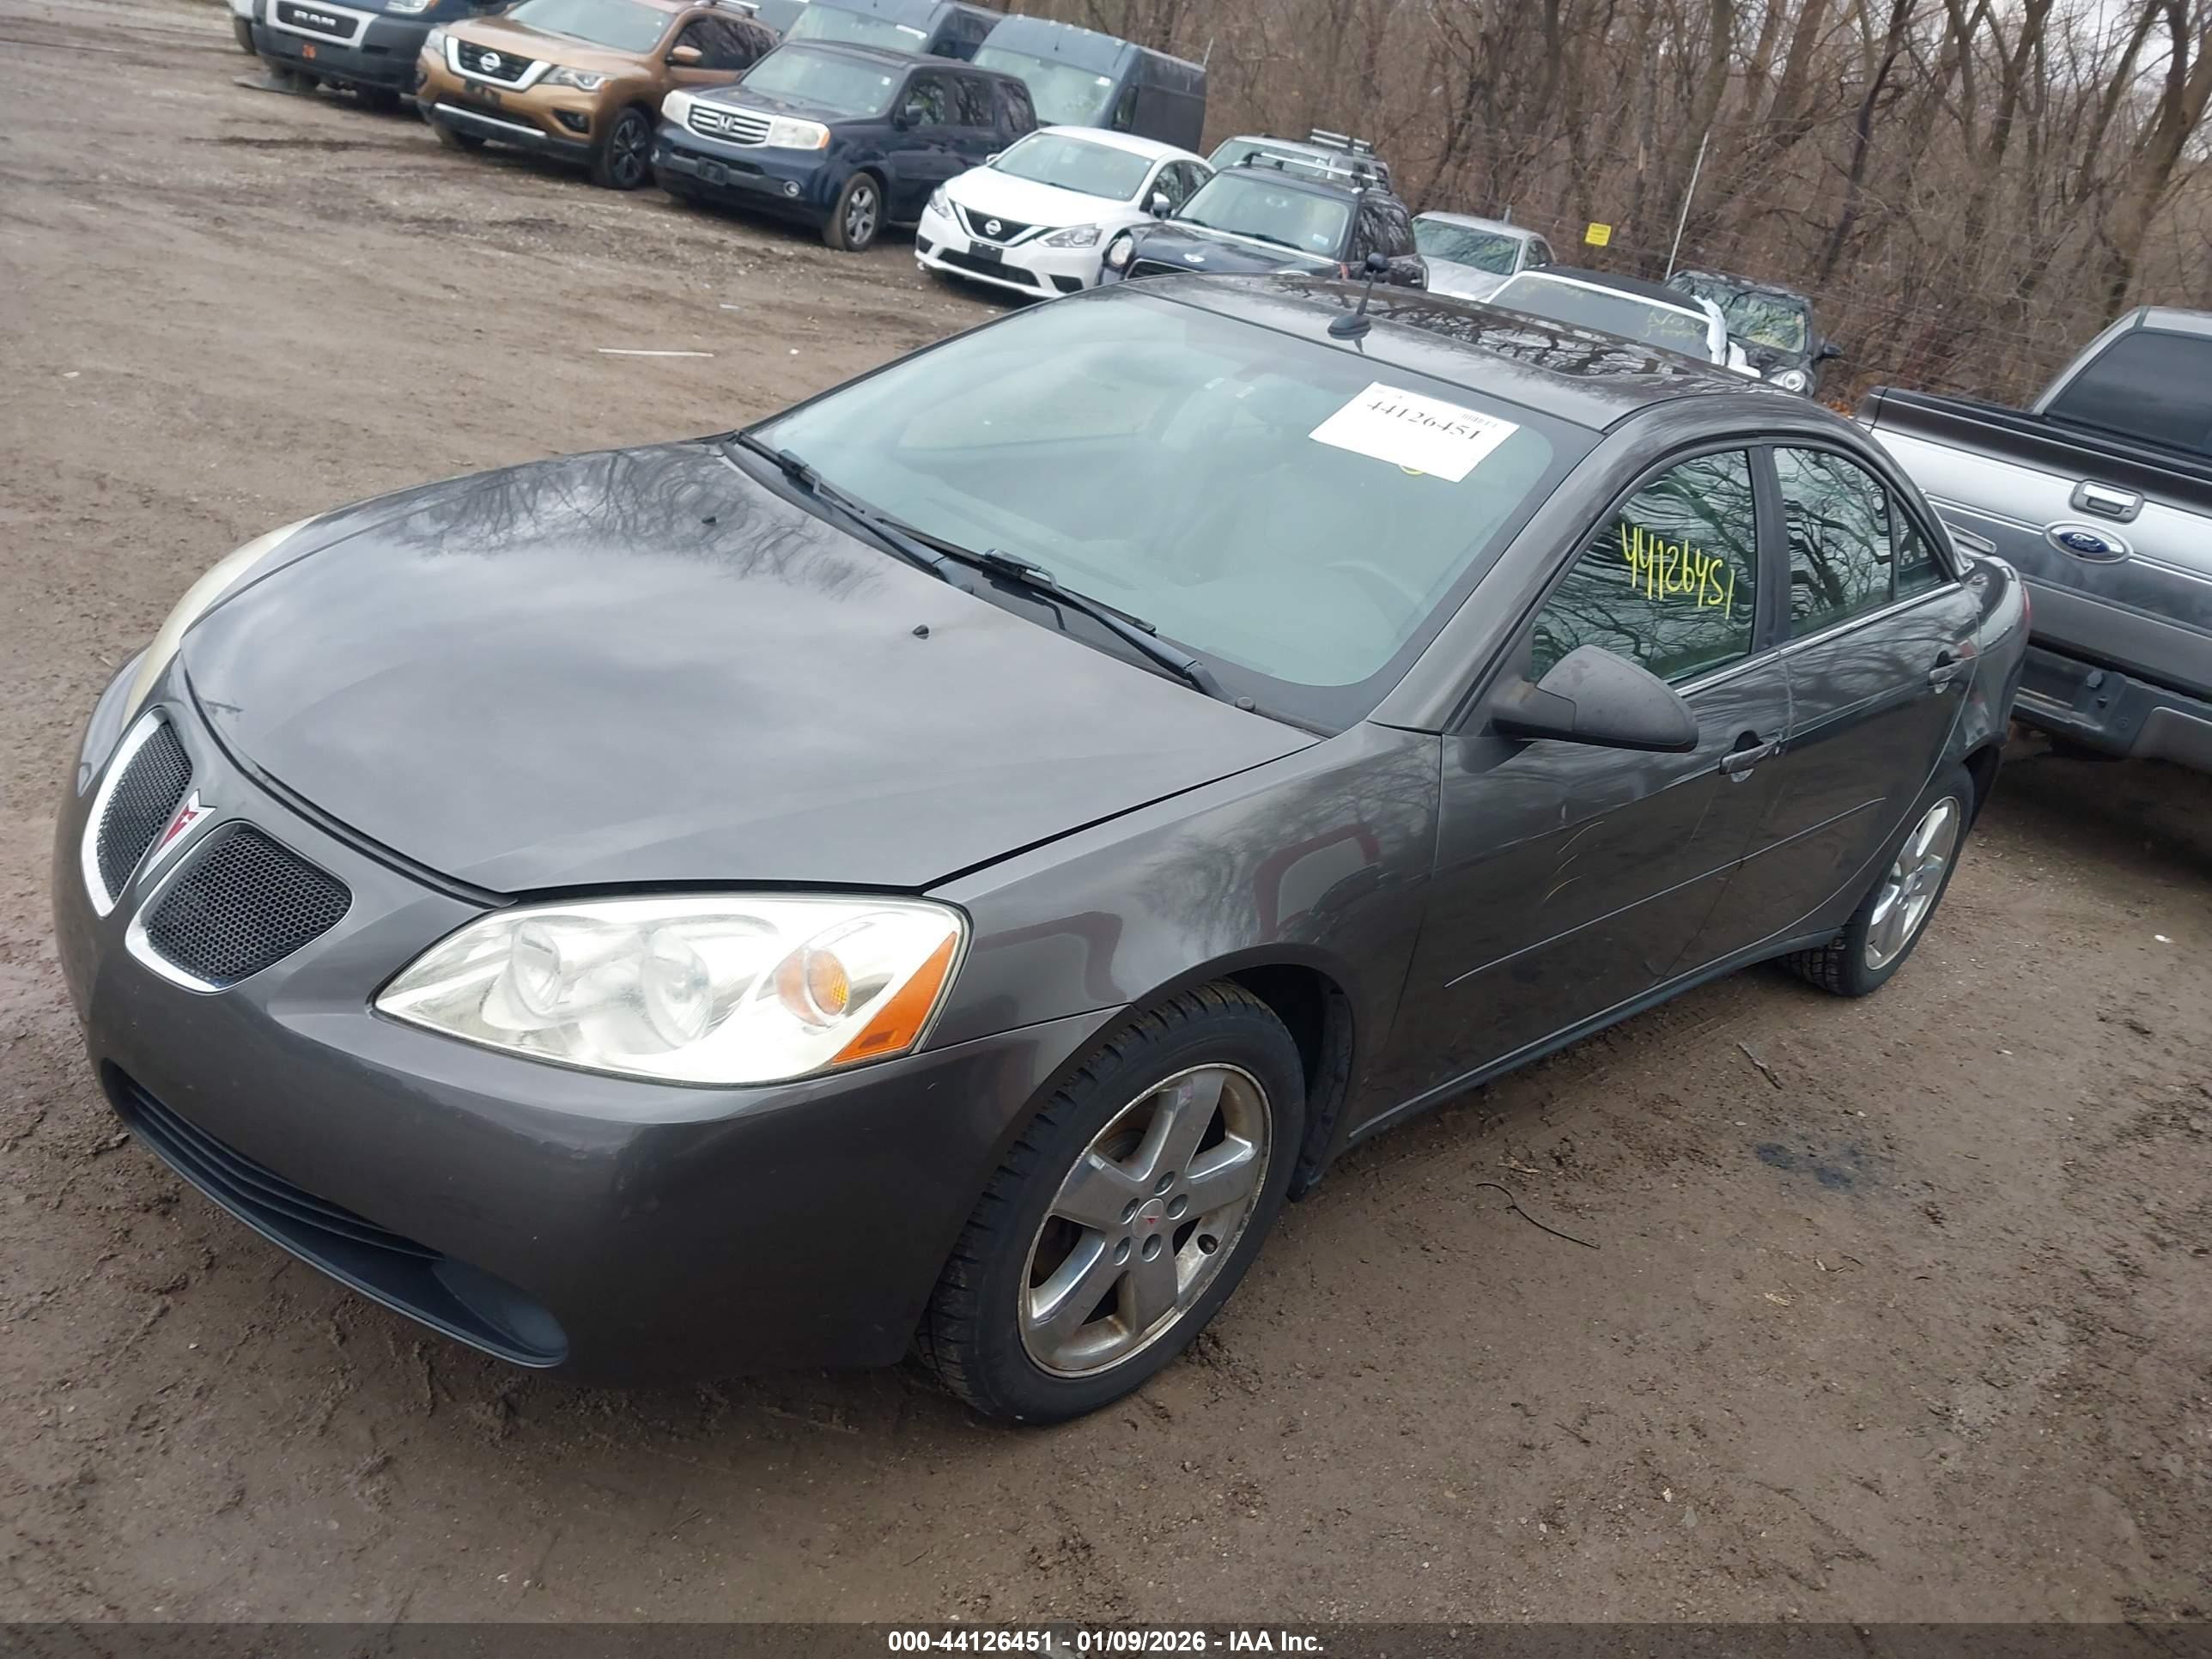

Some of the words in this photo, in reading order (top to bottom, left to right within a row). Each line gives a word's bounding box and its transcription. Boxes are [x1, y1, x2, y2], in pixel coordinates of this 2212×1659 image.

[293, 9, 337, 27] RAM
[1366, 400, 1480, 440] 44126451
[2067, 533, 2101, 551] Ford
[1621, 521, 1735, 620] 44126451
